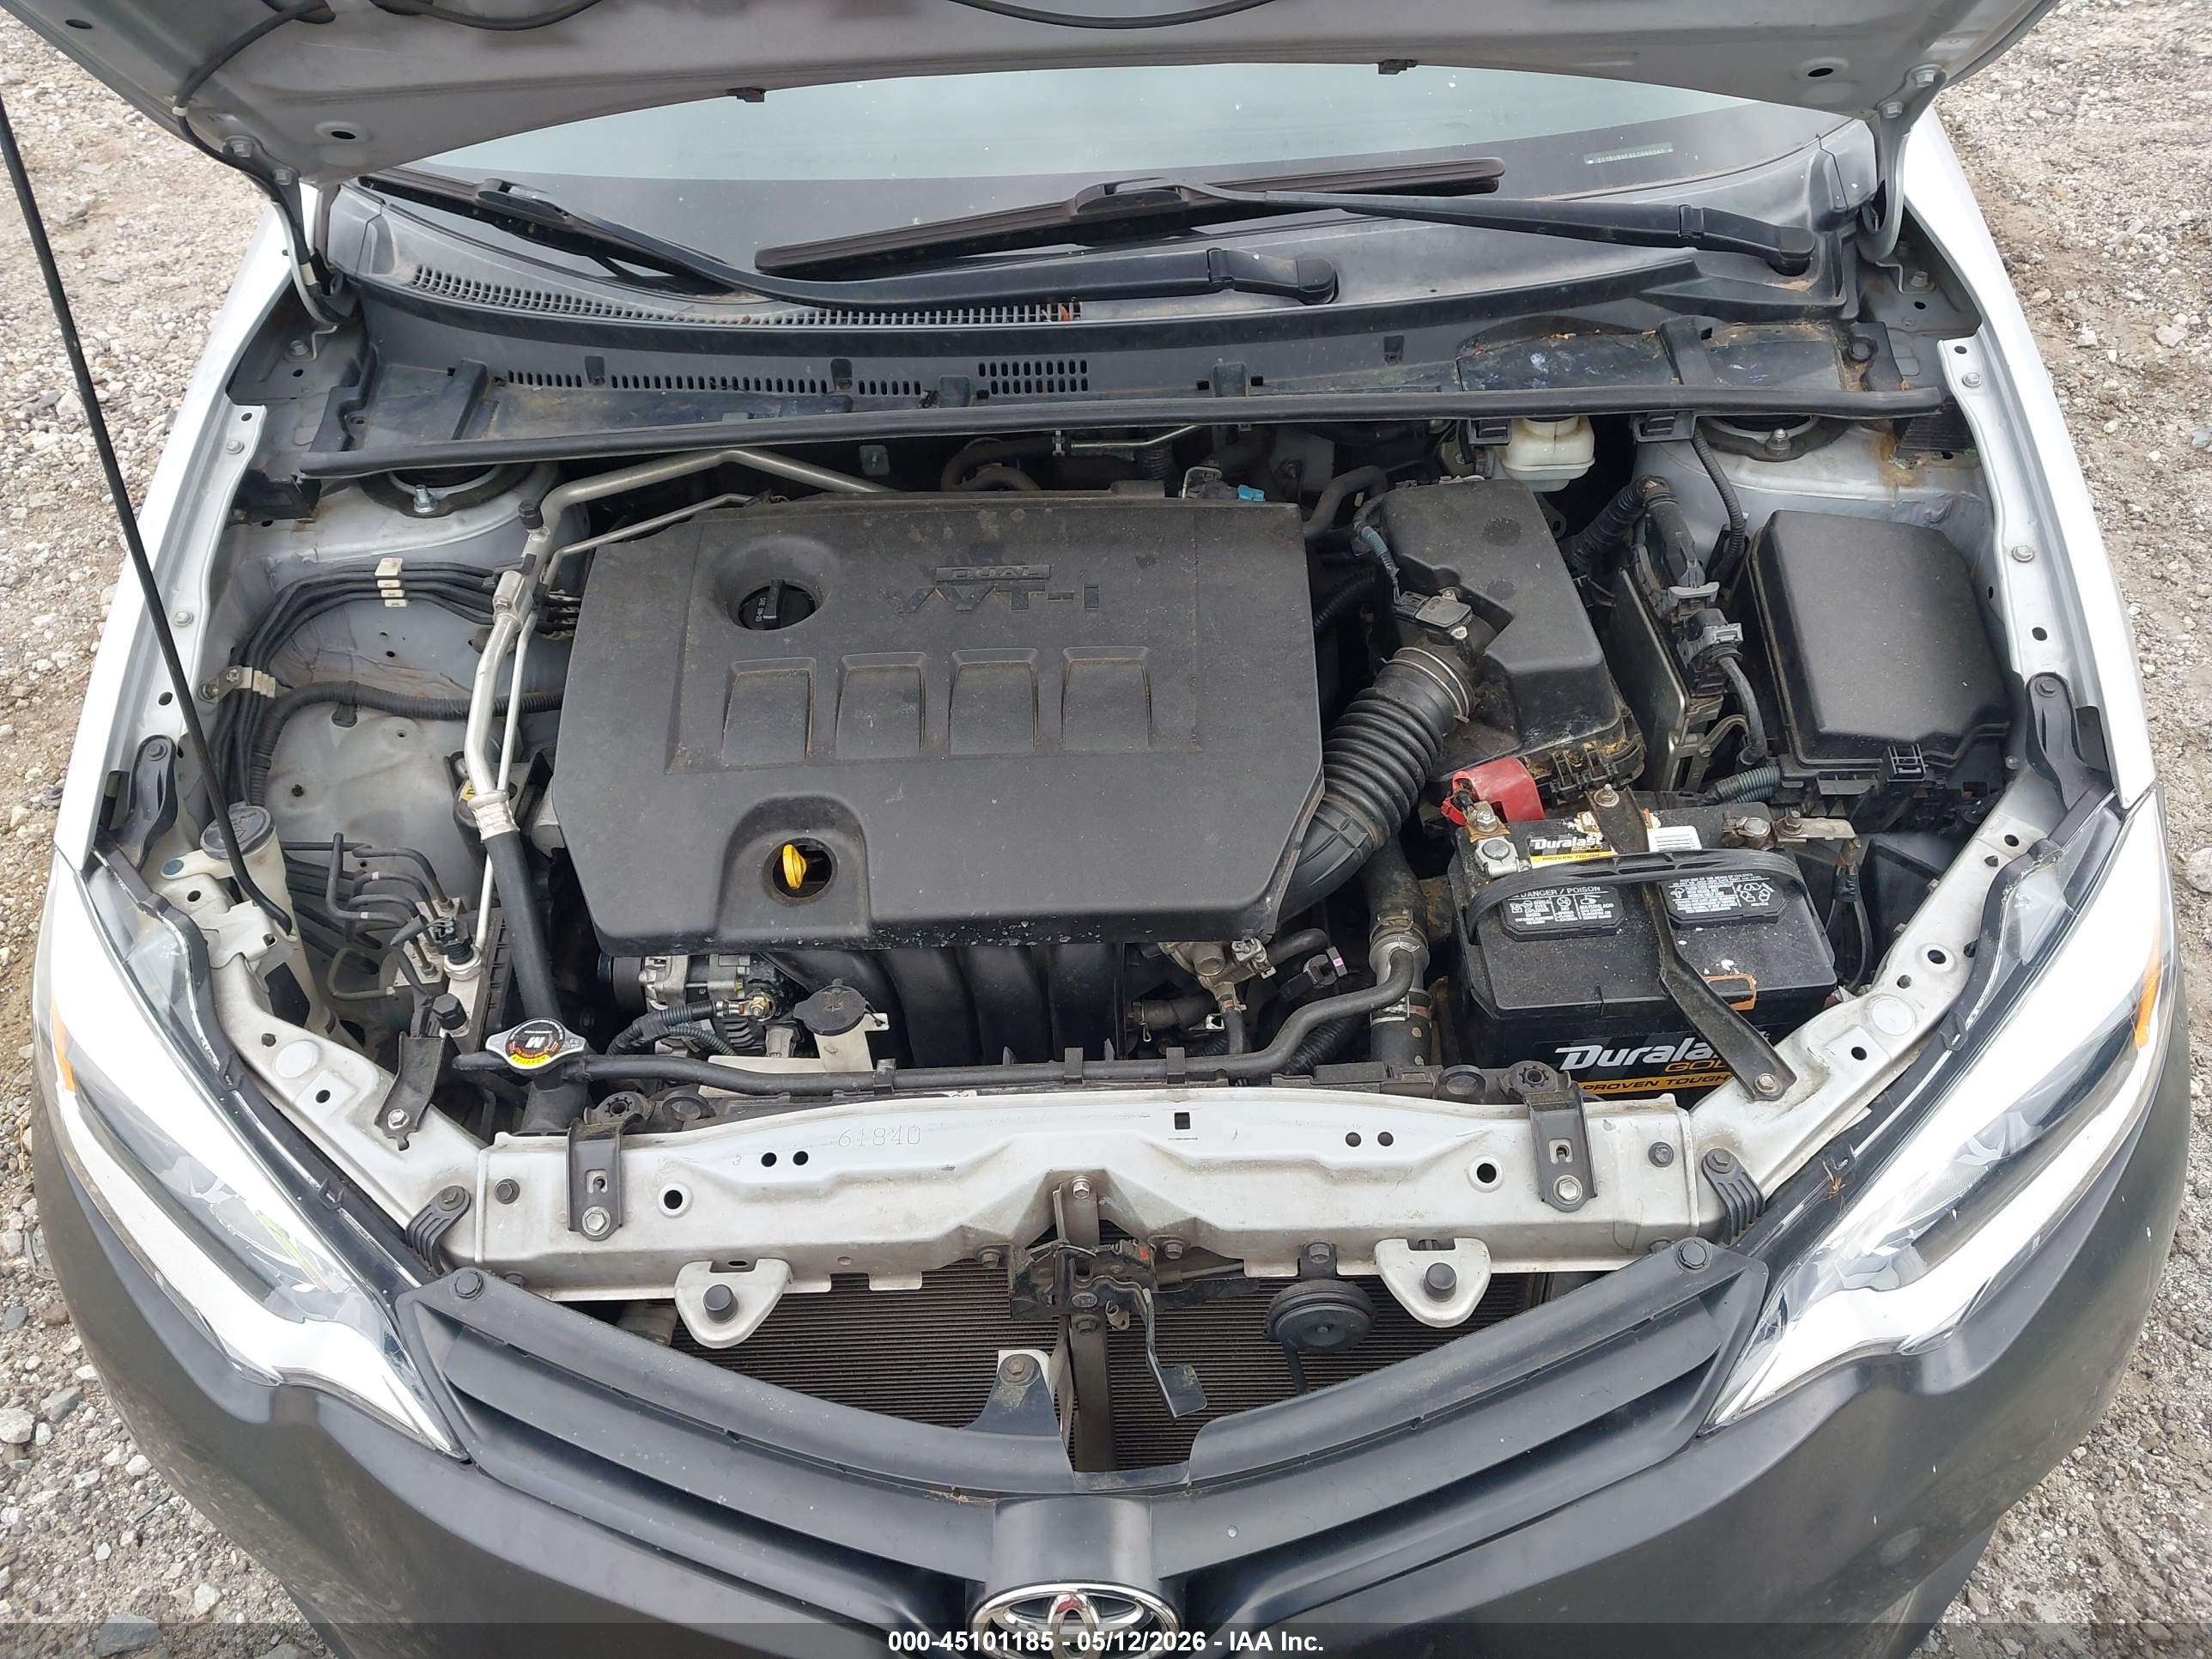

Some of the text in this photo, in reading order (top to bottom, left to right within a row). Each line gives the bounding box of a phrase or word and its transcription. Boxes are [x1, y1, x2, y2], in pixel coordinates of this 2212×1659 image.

[1530, 834, 1605, 850] Duralast
[1520, 889, 1558, 898] DANGER
[1566, 885, 1601, 894] POISON
[1664, 1058, 1727, 1073] GOL
[1582, 1073, 1732, 1091] PROVEN TOUGH
[837, 1124, 921, 1148] 61840
